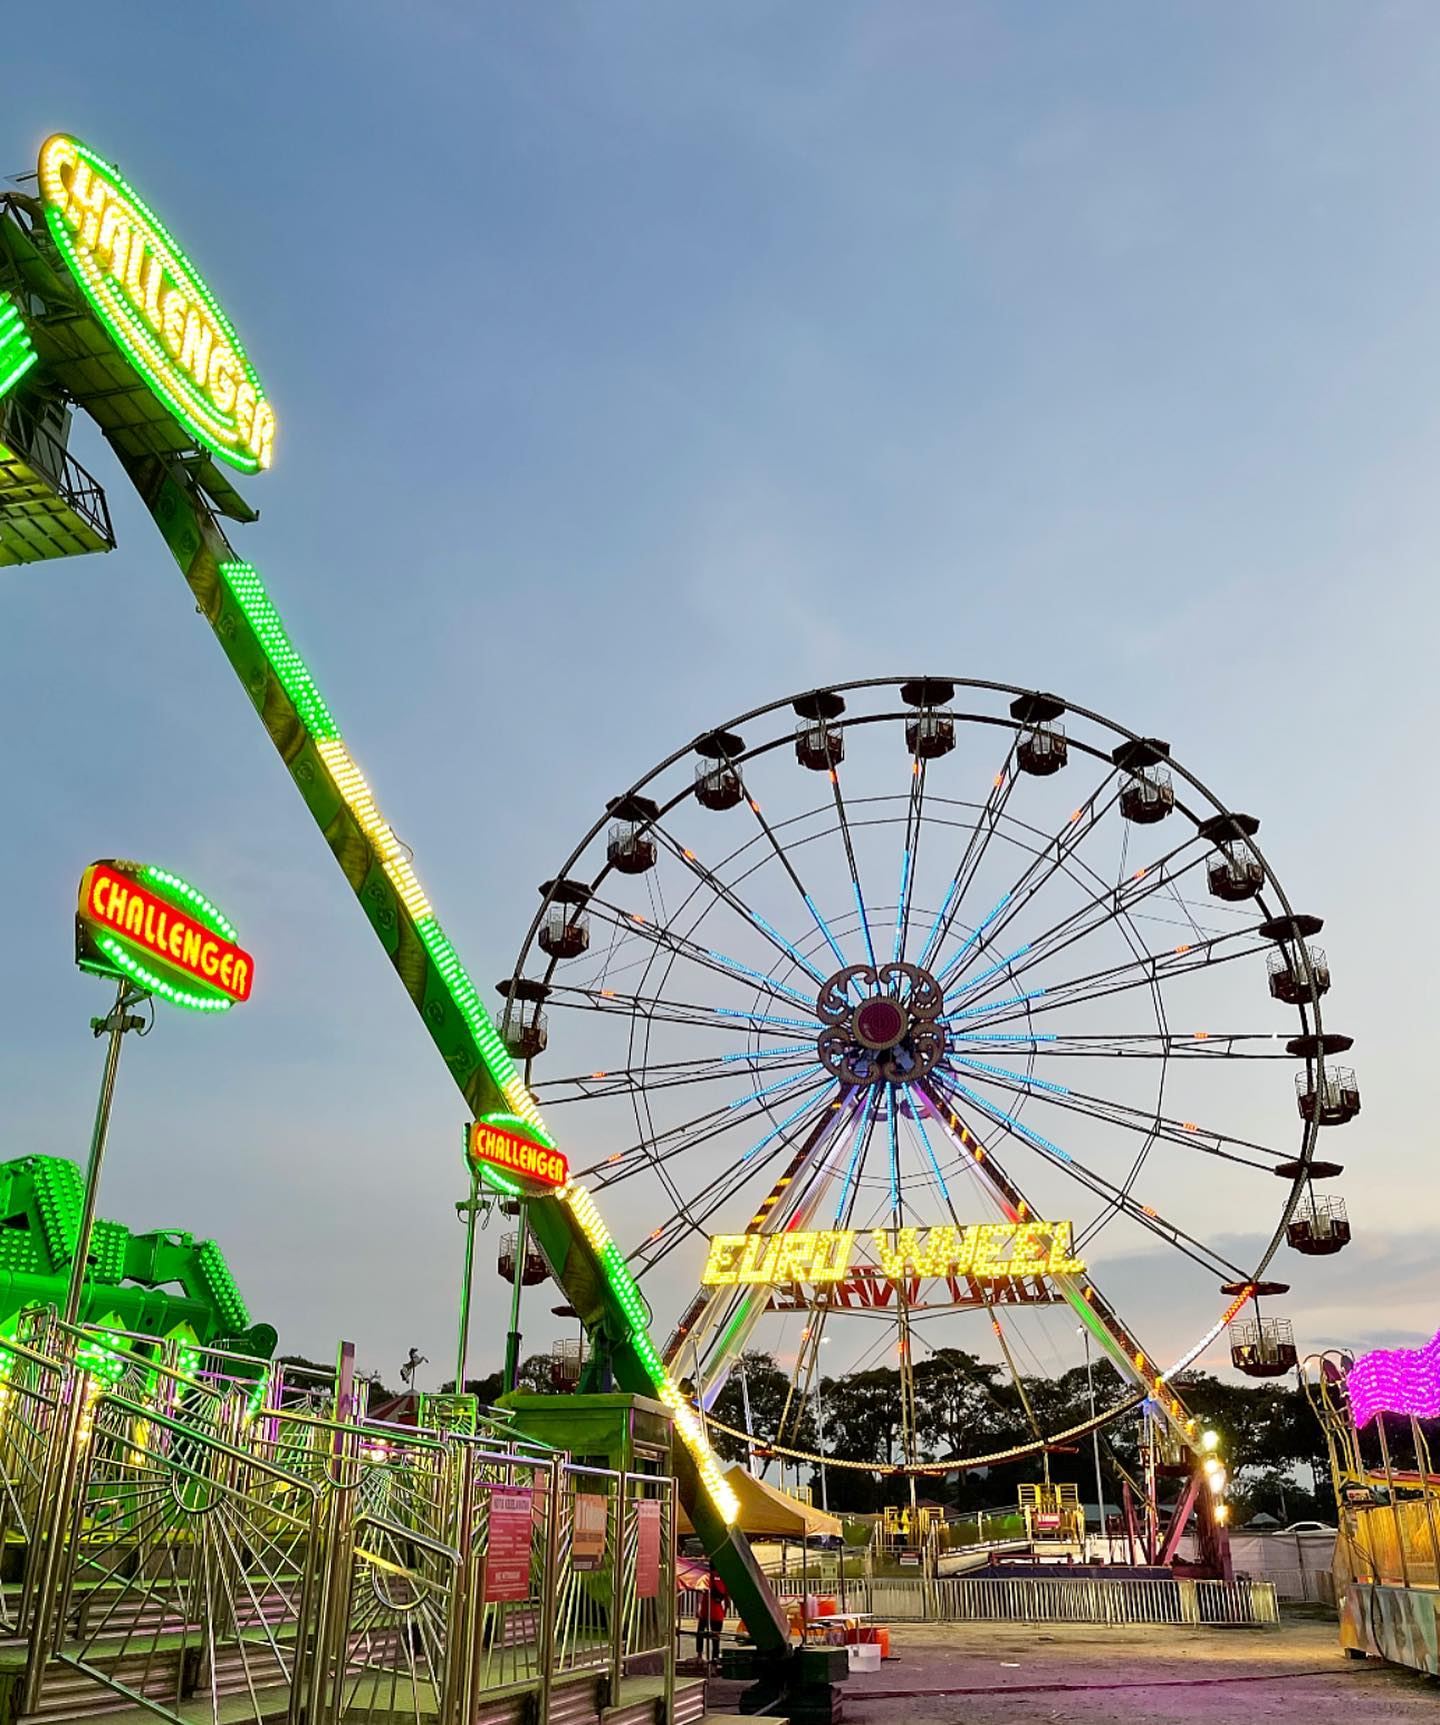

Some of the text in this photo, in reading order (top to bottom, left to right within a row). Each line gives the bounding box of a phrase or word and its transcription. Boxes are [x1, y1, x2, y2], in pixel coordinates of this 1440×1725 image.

[41, 137, 274, 469] CHALLENGER
[93, 877, 247, 995] CHALLENGER
[476, 1129, 564, 1183] CHALLENGER
[702, 1222, 1085, 1285] EURO WHEEL
